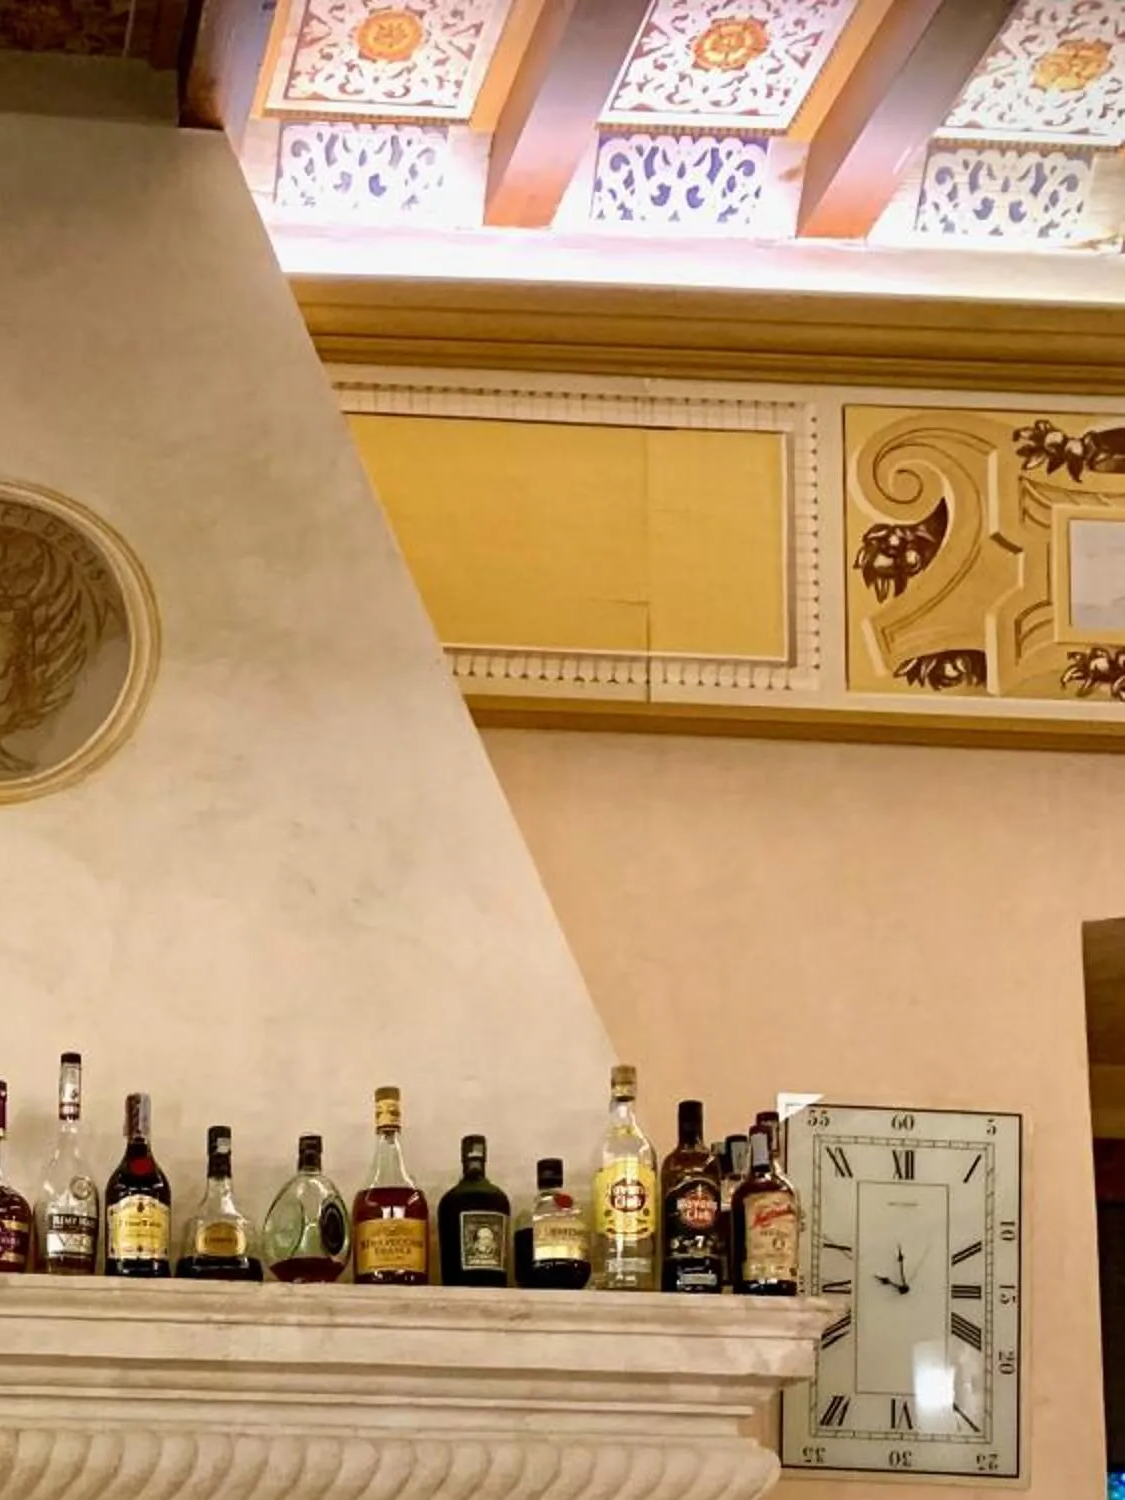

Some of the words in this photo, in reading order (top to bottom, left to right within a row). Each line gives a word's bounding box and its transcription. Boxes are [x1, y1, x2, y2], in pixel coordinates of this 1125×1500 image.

[1, 505, 108, 581] FIDELIS
[807, 1109, 830, 1127] 55
[891, 1114, 915, 1131] 60
[986, 1118, 997, 1136] 5
[891, 1150, 915, 1180] XII
[999, 1221, 1016, 1242] 10
[998, 1285, 1017, 1305] 15
[998, 1351, 1016, 1376] 20
[803, 1446, 828, 1464] 35
[888, 1450, 913, 1468] 30
[975, 1452, 1000, 1471] 25
